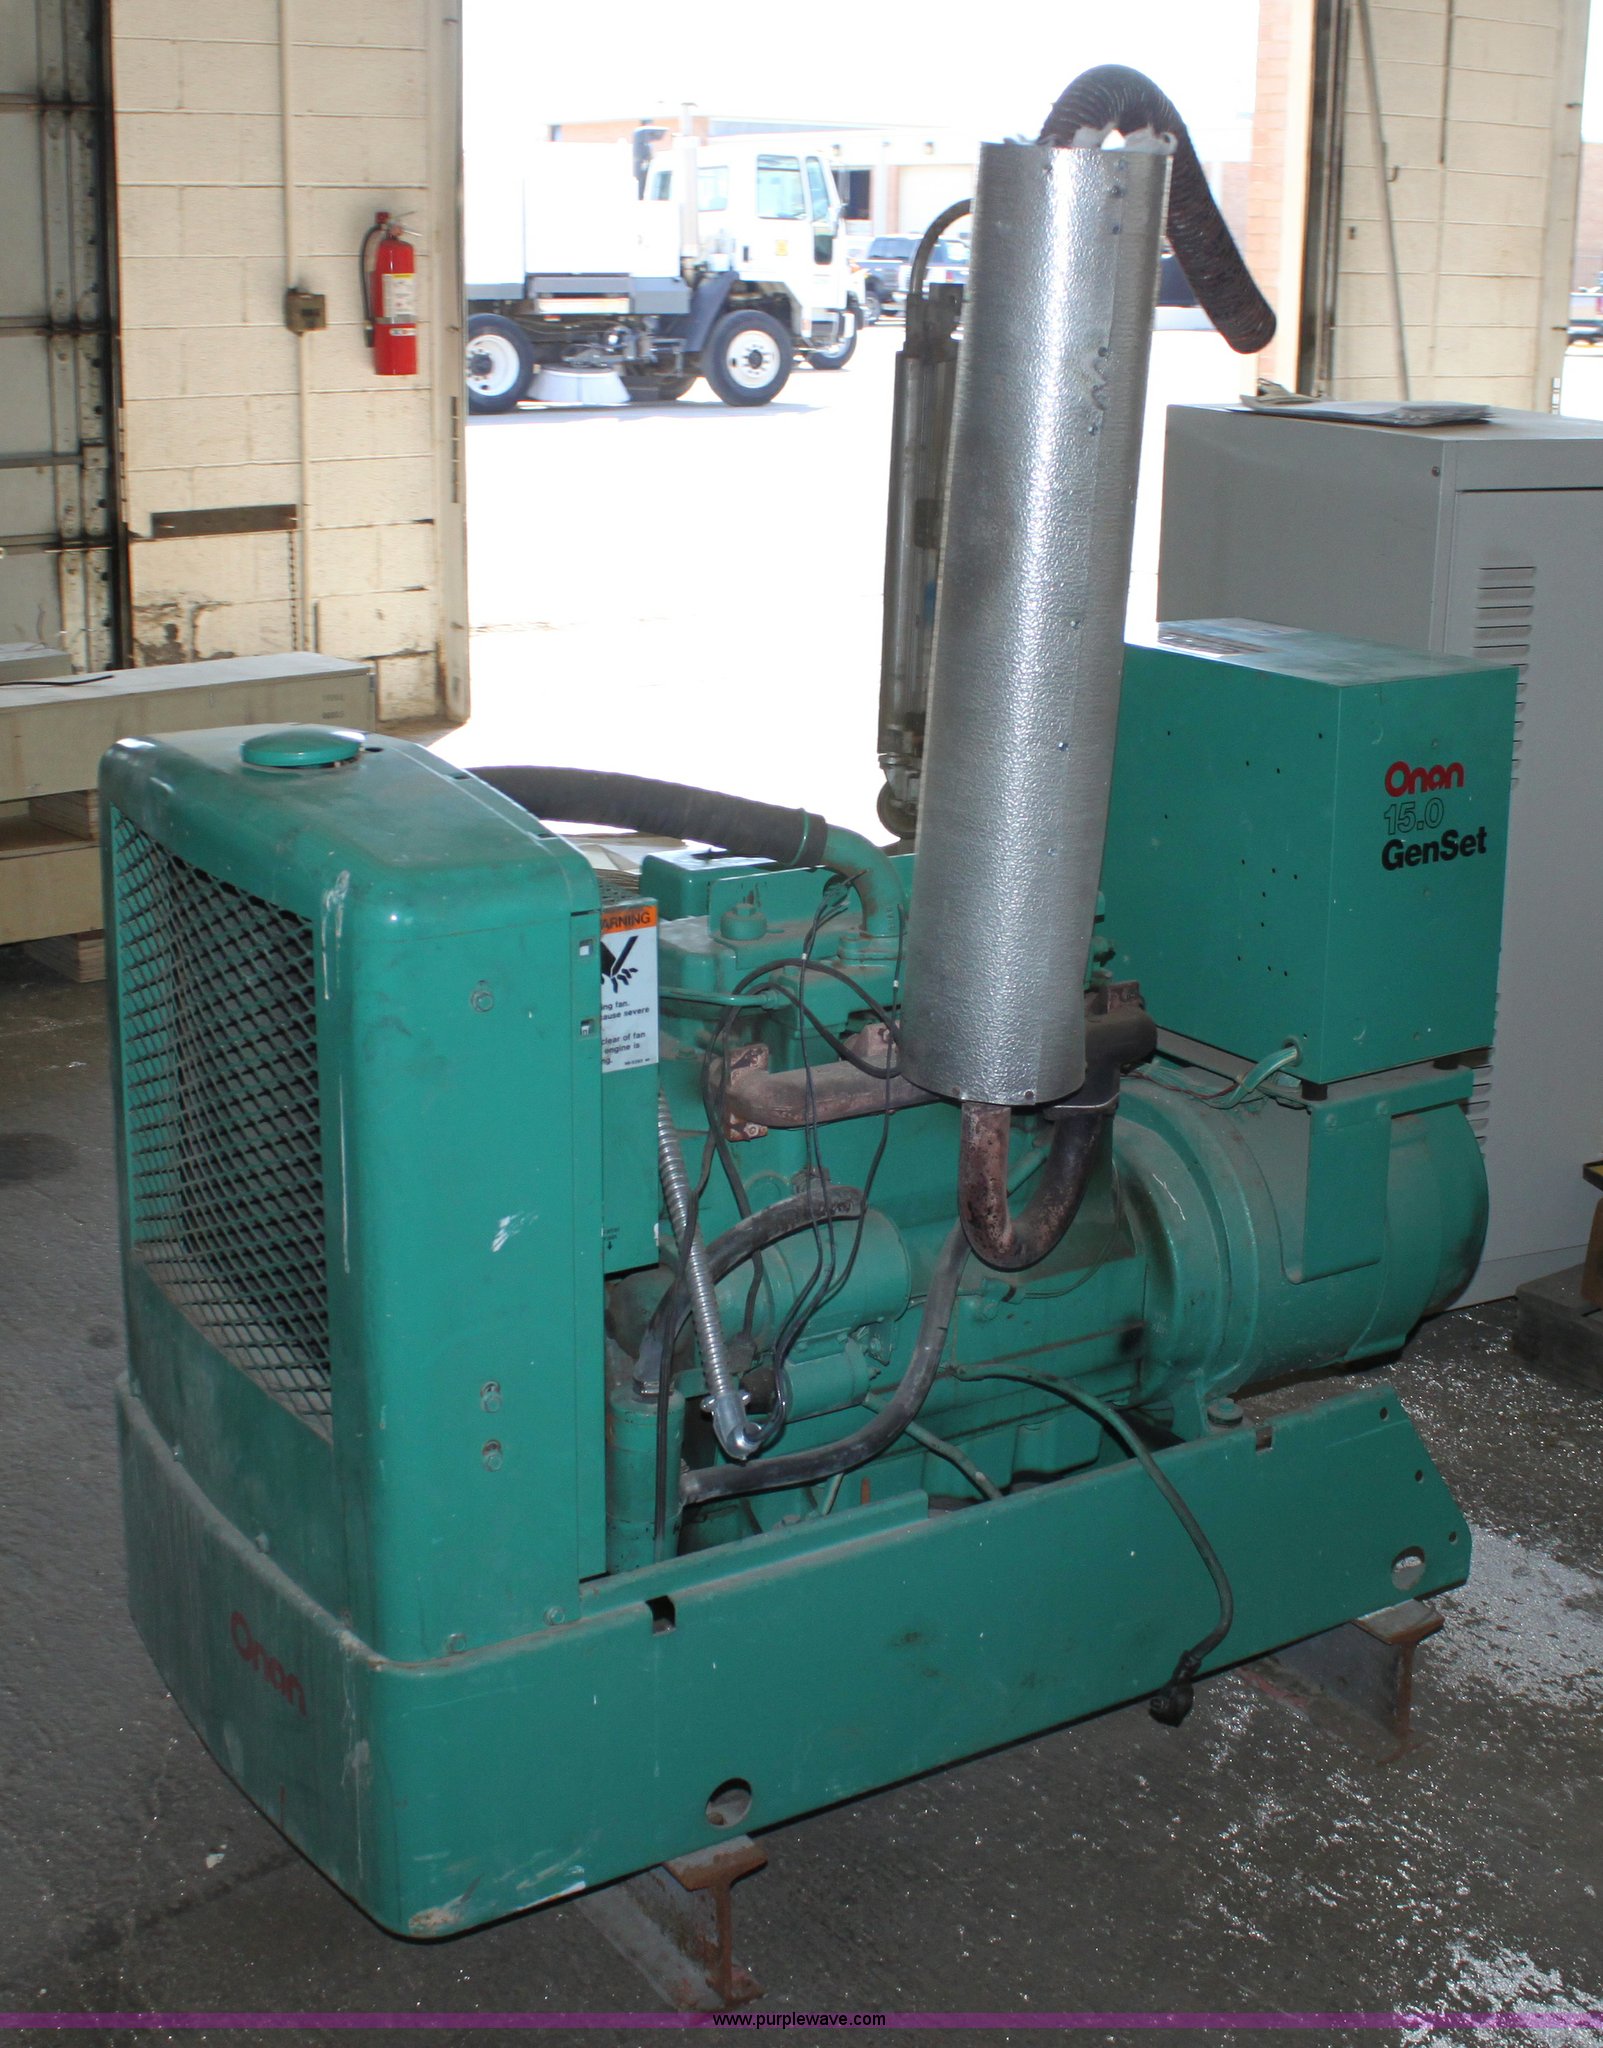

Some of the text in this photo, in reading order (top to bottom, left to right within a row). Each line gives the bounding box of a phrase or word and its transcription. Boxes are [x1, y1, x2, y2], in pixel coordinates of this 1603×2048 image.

[1384, 760, 1465, 798] Onan
[1383, 797, 1445, 835] 15.0
[1381, 826, 1488, 871] GenSet
[602, 911, 651, 929] ARNING
[623, 1006, 650, 1017] severe
[604, 1044, 631, 1055] engine
[622, 1032, 631, 1041] of
[633, 1031, 646, 1040] fan
[230, 1610, 307, 1719] Onan
